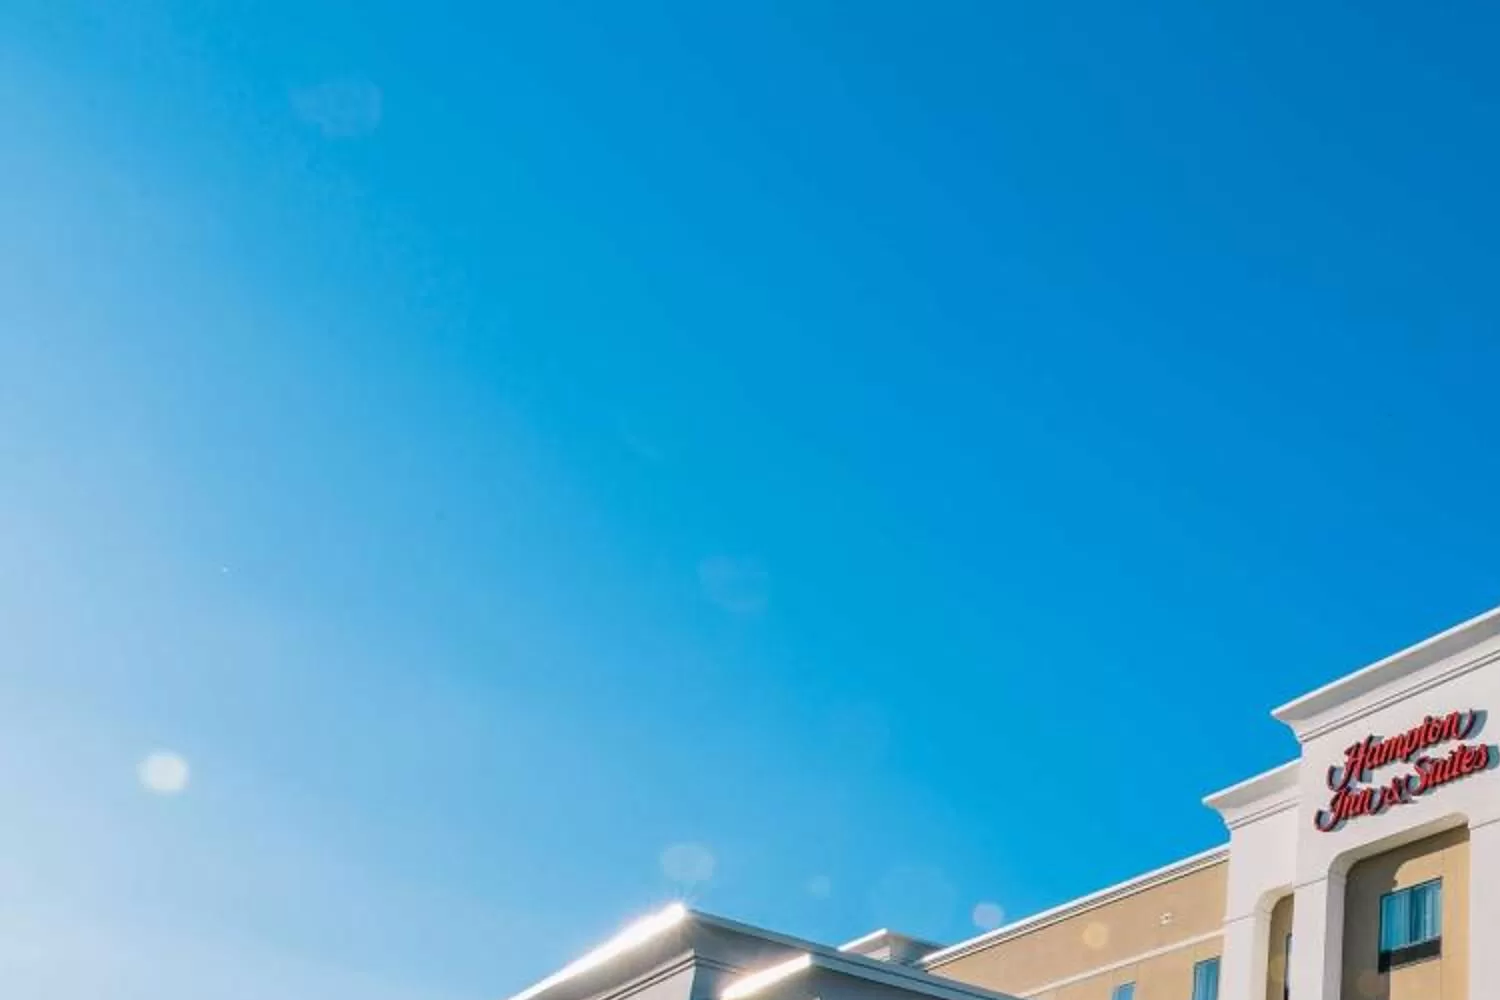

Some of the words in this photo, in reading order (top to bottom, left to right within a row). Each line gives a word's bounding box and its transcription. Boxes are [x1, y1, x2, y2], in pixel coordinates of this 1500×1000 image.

[1314, 787, 1384, 832] Inn
[1382, 775, 1405, 805] &
[1405, 743, 1490, 797] Suites
[1328, 709, 1477, 792] Hampton
